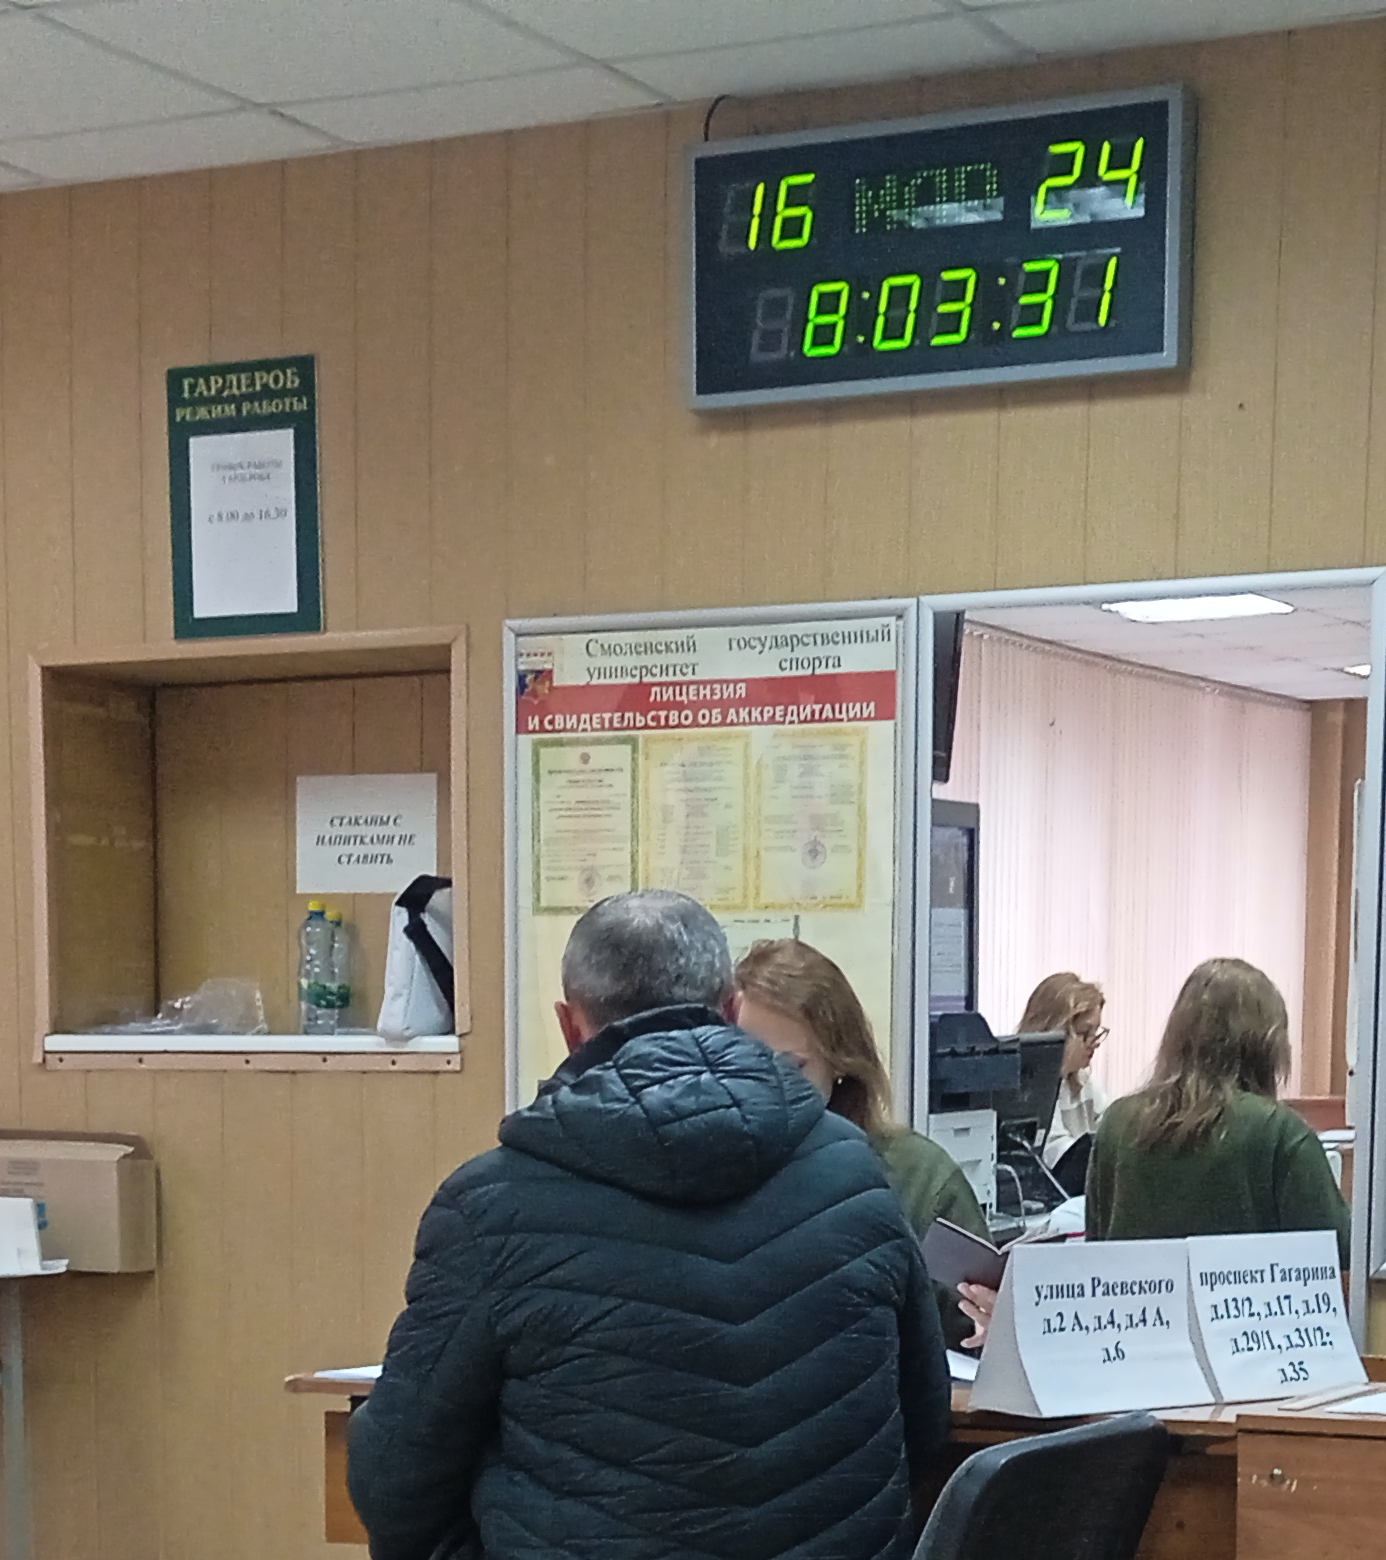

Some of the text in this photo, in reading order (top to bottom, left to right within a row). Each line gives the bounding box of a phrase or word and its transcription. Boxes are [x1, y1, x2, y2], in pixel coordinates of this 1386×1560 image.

[748, 172, 816, 251] 16
[1034, 136, 1145, 219] 24
[802, 256, 1118, 358] 8:03:31
[181, 367, 301, 400] ГАРДЕРОБ
[175, 395, 308, 423] РЕЖИМ РАБОТЫ
[585, 623, 893, 657] Смоленский государственный
[586, 653, 843, 685] университет спорта
[649, 682, 747, 705] ЛИЦЕНЗИЯ
[527, 701, 876, 732] И СВИДЕТЕЛЬСТВО ОБ АККРЕДИТАЦИИ
[329, 813, 403, 828] СТАКАНЫ С
[315, 833, 416, 847] НАПИТКАМИ НЕ
[337, 853, 394, 865] СТАВИТЬ
[1034, 1275, 1174, 1307] улица Раевского
[1199, 1262, 1337, 1290] проспект Гагарина
[1042, 1306, 1170, 1336] д.2 А, д.4, д.4 А,
[1210, 1291, 1337, 1322] д.13/2, д.17, д.19,
[1102, 1340, 1126, 1364] д.6
[1231, 1325, 1334, 1355] д.29/1, д.31/2;
[1279, 1360, 1310, 1384] д.35
